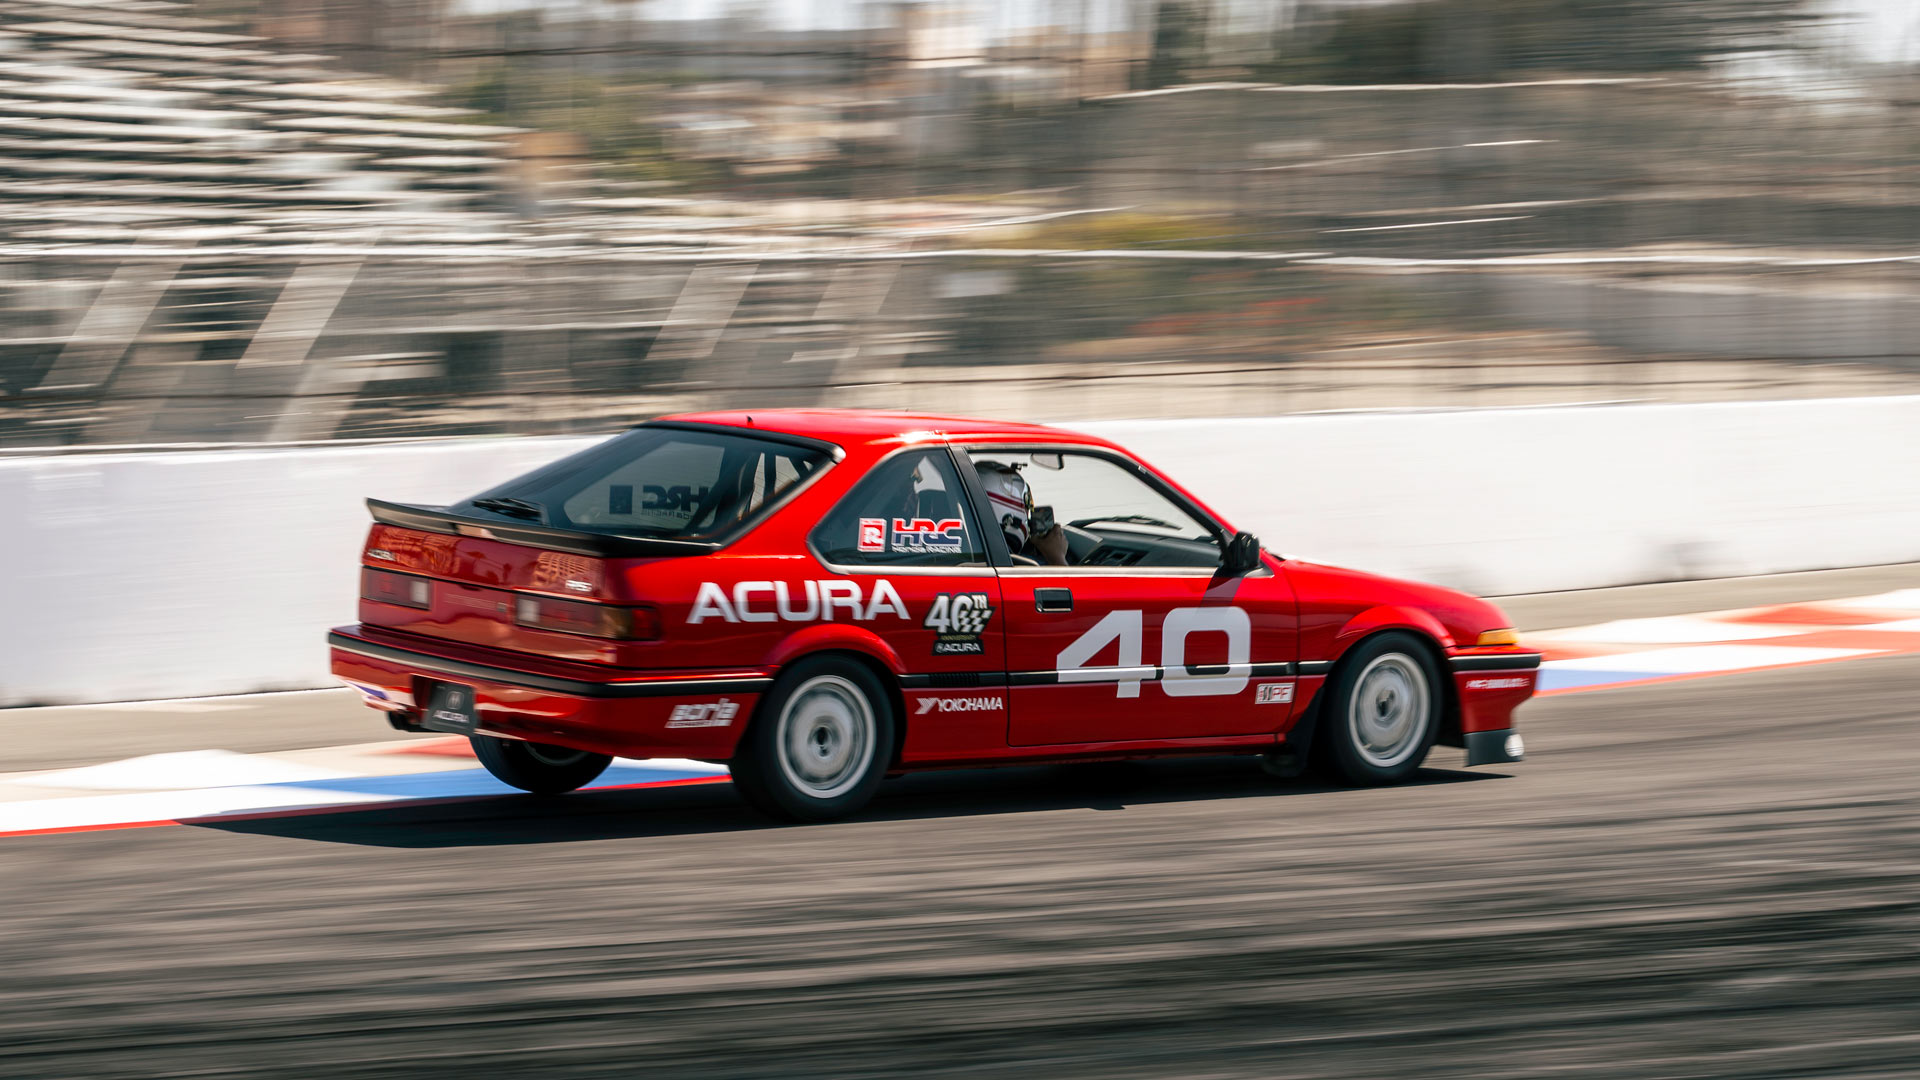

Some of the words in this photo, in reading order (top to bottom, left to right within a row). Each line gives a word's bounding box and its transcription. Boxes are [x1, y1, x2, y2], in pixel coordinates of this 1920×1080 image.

[891, 518, 963, 547] HRC
[686, 579, 910, 625] ACURA
[942, 643, 982, 653] ACURA
[1056, 606, 1252, 698] 40
[937, 696, 1004, 712] YOKOHAMA
[432, 709, 470, 724] ACURA
